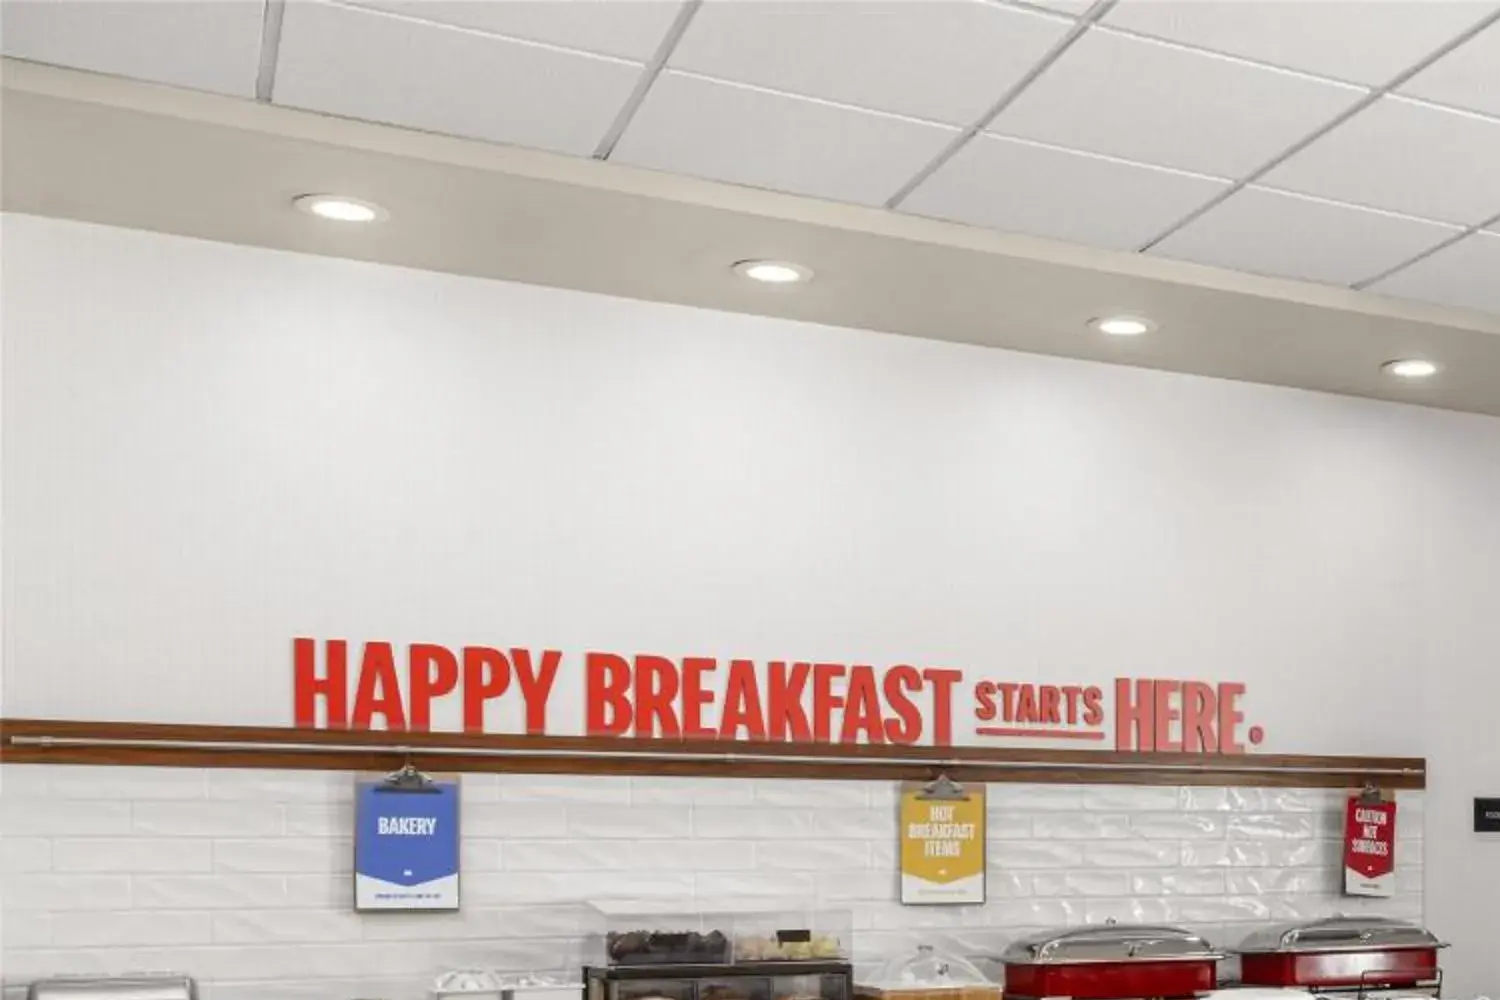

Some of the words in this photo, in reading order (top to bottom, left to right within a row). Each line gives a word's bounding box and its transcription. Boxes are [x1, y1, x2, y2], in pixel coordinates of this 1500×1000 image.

[294, 637, 562, 734] HAPPY
[585, 652, 963, 746] BREAKFAST
[975, 681, 1104, 725] STARTS
[1115, 678, 1264, 754] HERE.
[377, 816, 437, 835] BAKERY
